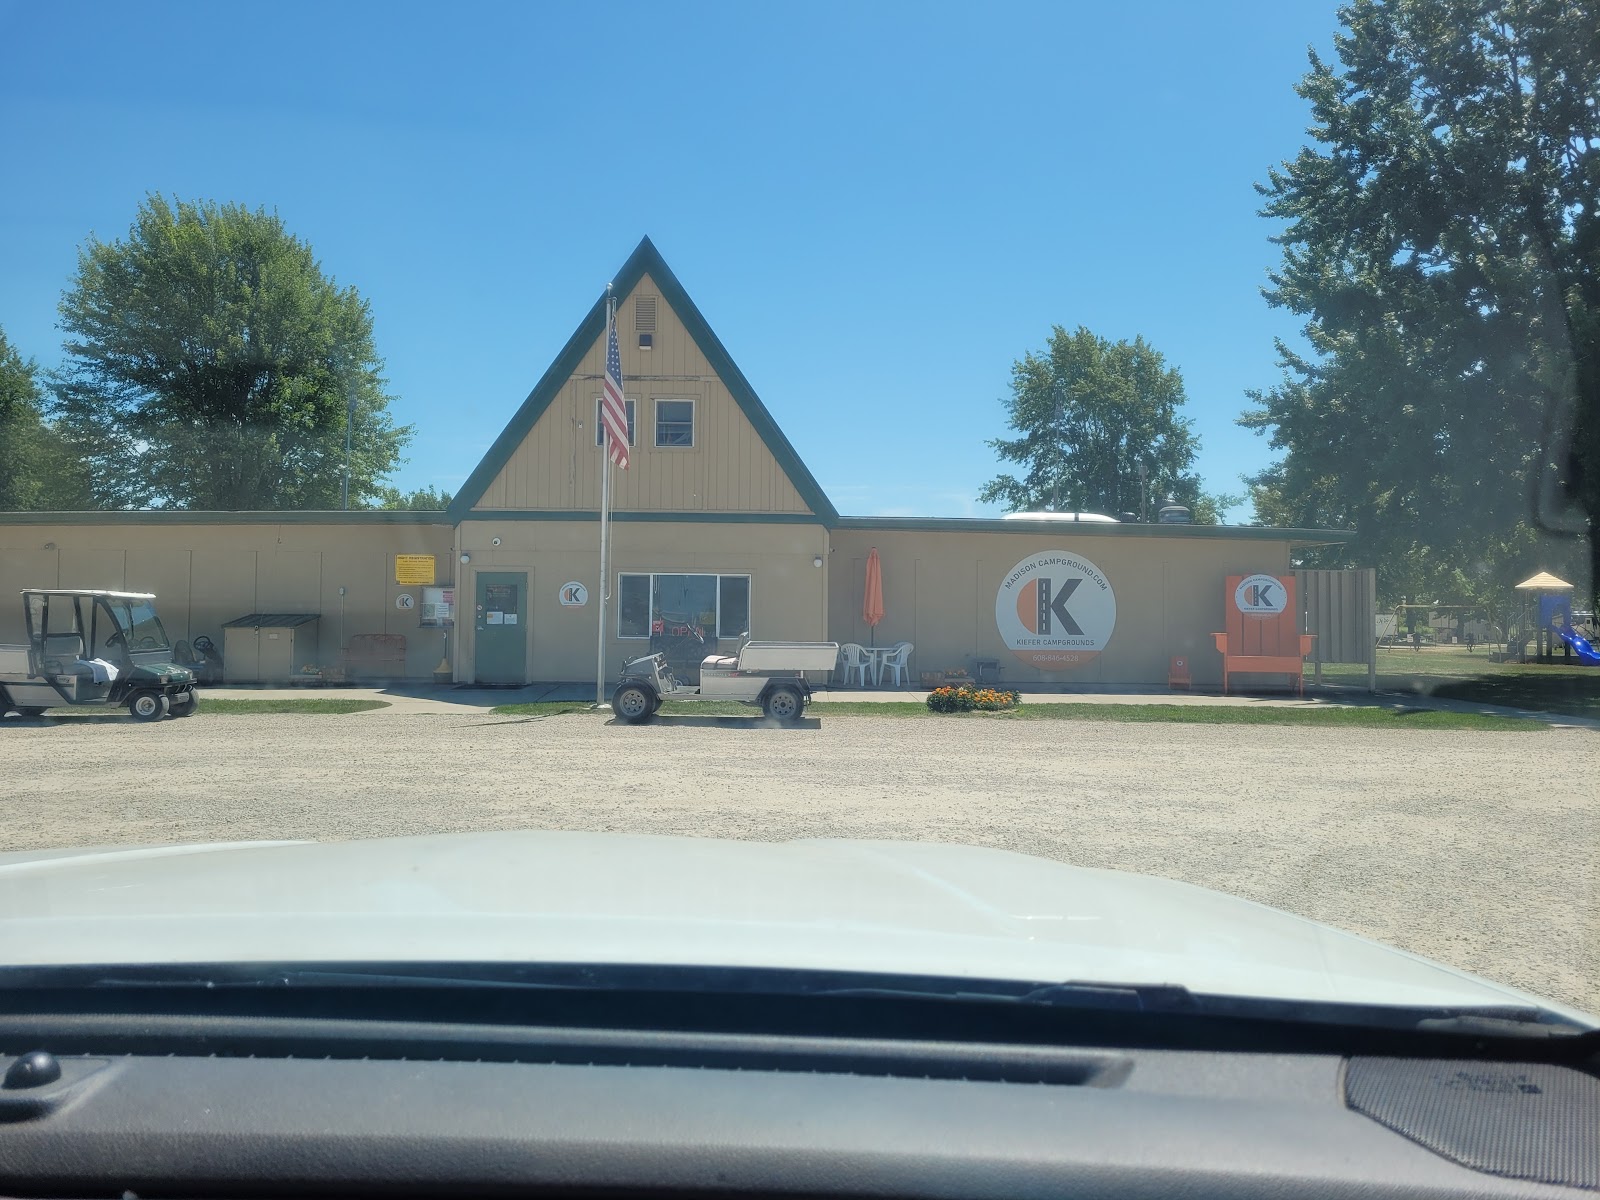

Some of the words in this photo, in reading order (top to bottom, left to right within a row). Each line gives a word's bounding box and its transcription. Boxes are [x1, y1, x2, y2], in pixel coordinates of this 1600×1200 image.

[1005, 562, 1037, 589] MADISON
[1038, 558, 1108, 591] CAMPGROUND.COM
[1038, 578, 1085, 635] K
[1253, 585, 1274, 606] K
[671, 626, 704, 637] OPN
